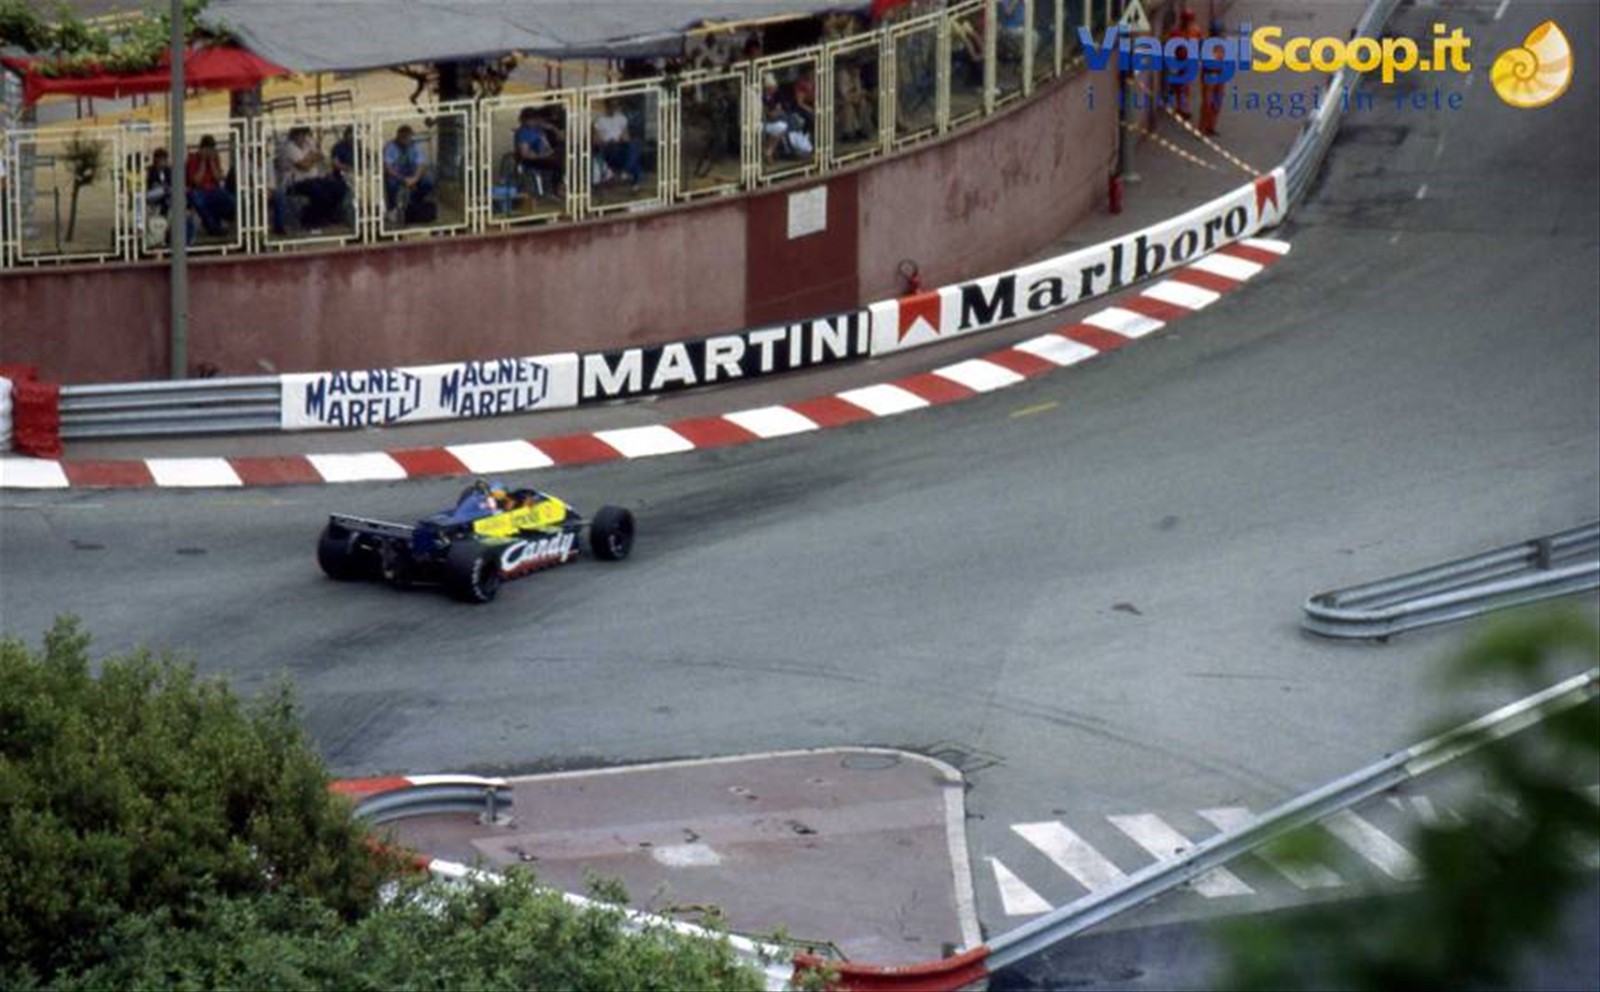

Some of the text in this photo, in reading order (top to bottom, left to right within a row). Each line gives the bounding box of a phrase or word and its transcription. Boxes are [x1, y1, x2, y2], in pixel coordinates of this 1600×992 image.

[957, 203, 1248, 330] Marlboro
[582, 311, 869, 398] MARTINI
[501, 532, 574, 571] Candy
